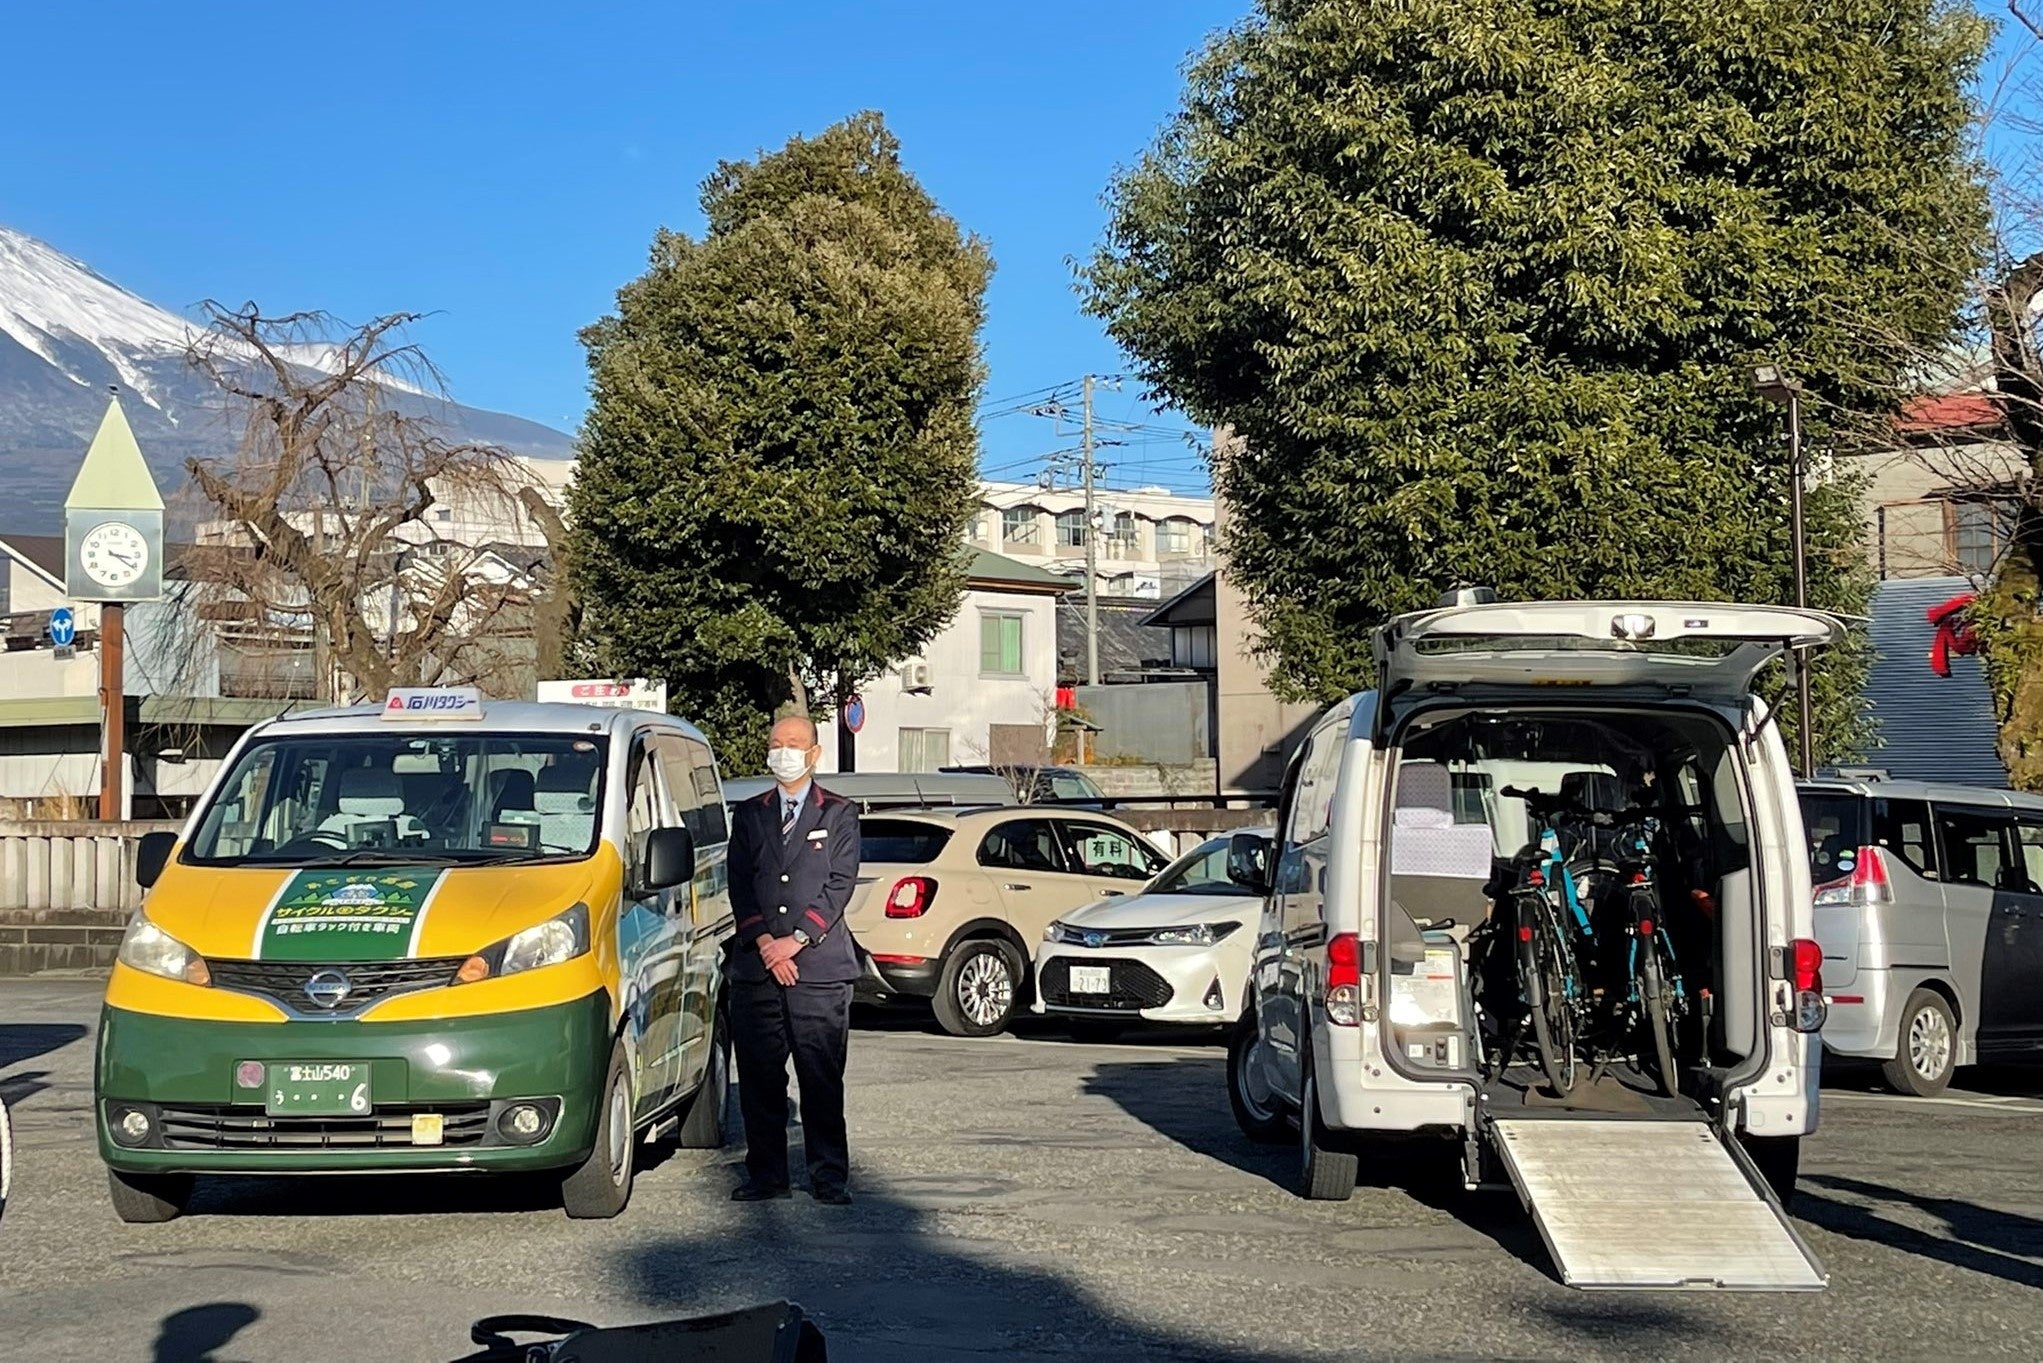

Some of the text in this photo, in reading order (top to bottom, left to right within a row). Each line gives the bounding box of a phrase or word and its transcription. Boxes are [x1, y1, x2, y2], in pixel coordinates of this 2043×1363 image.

[406, 696, 476, 709] 石川タクシー
[276, 922, 400, 935] 自転車ラック付き車両
[290, 1065, 350, 1081] 富士山540
